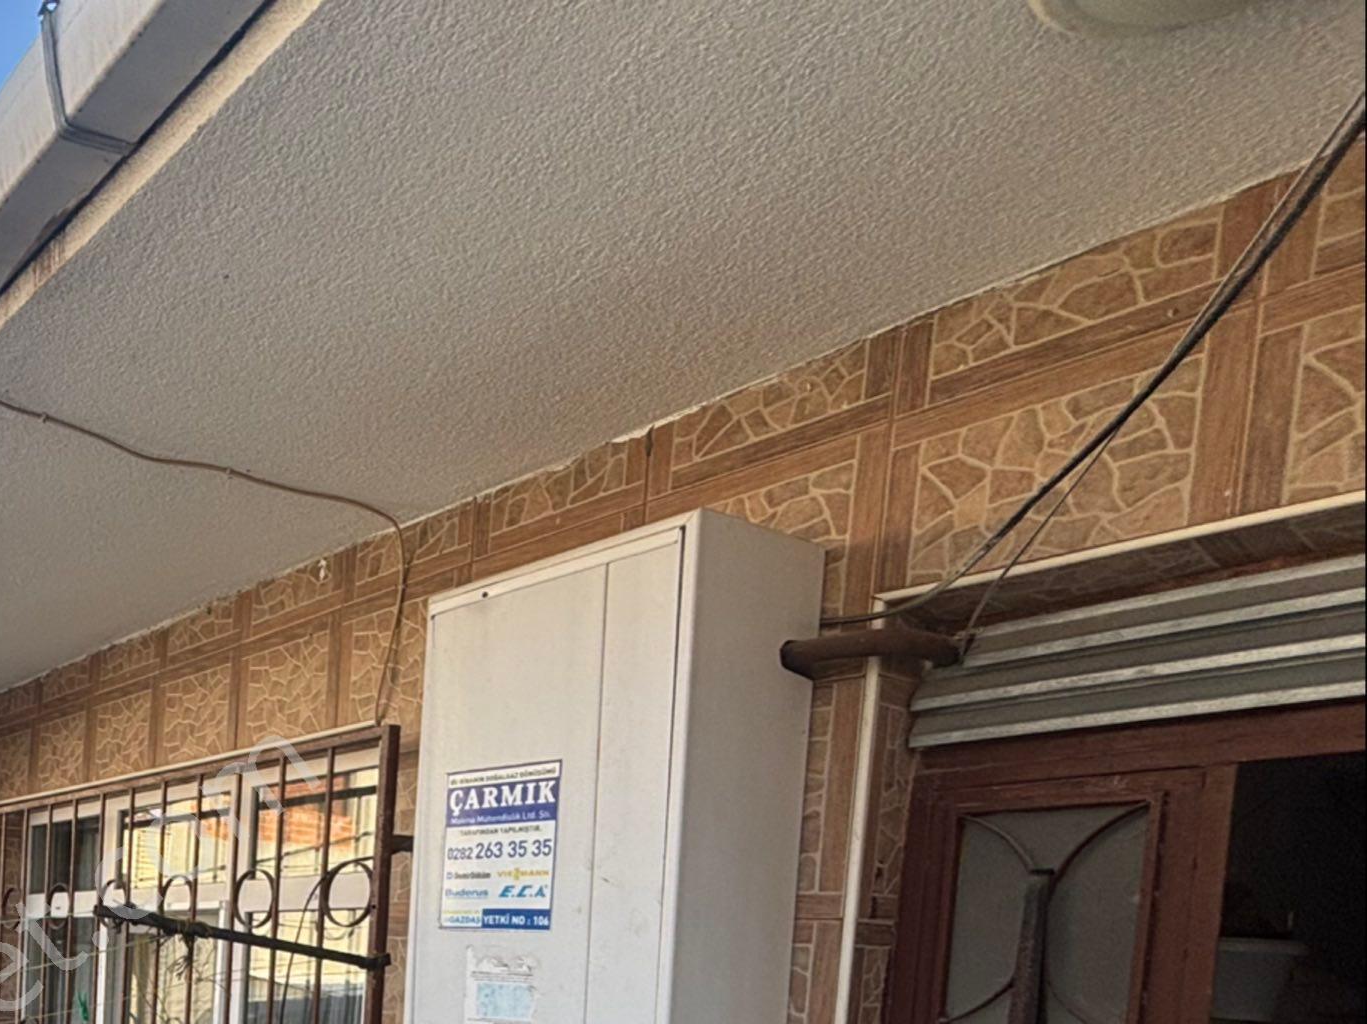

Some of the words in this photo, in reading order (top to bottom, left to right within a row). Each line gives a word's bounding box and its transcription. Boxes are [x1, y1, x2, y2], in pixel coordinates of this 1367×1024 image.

[450, 780, 556, 816] ÇARMIK
[447, 847, 473, 860] 0282
[475, 842, 503, 859] 263
[508, 840, 527, 858] 35
[532, 839, 552, 857] 35
[445, 888, 489, 897] Buderus
[483, 913, 510, 925] YETKİ
[511, 915, 525, 925] NO
[534, 915, 549, 926] 106
